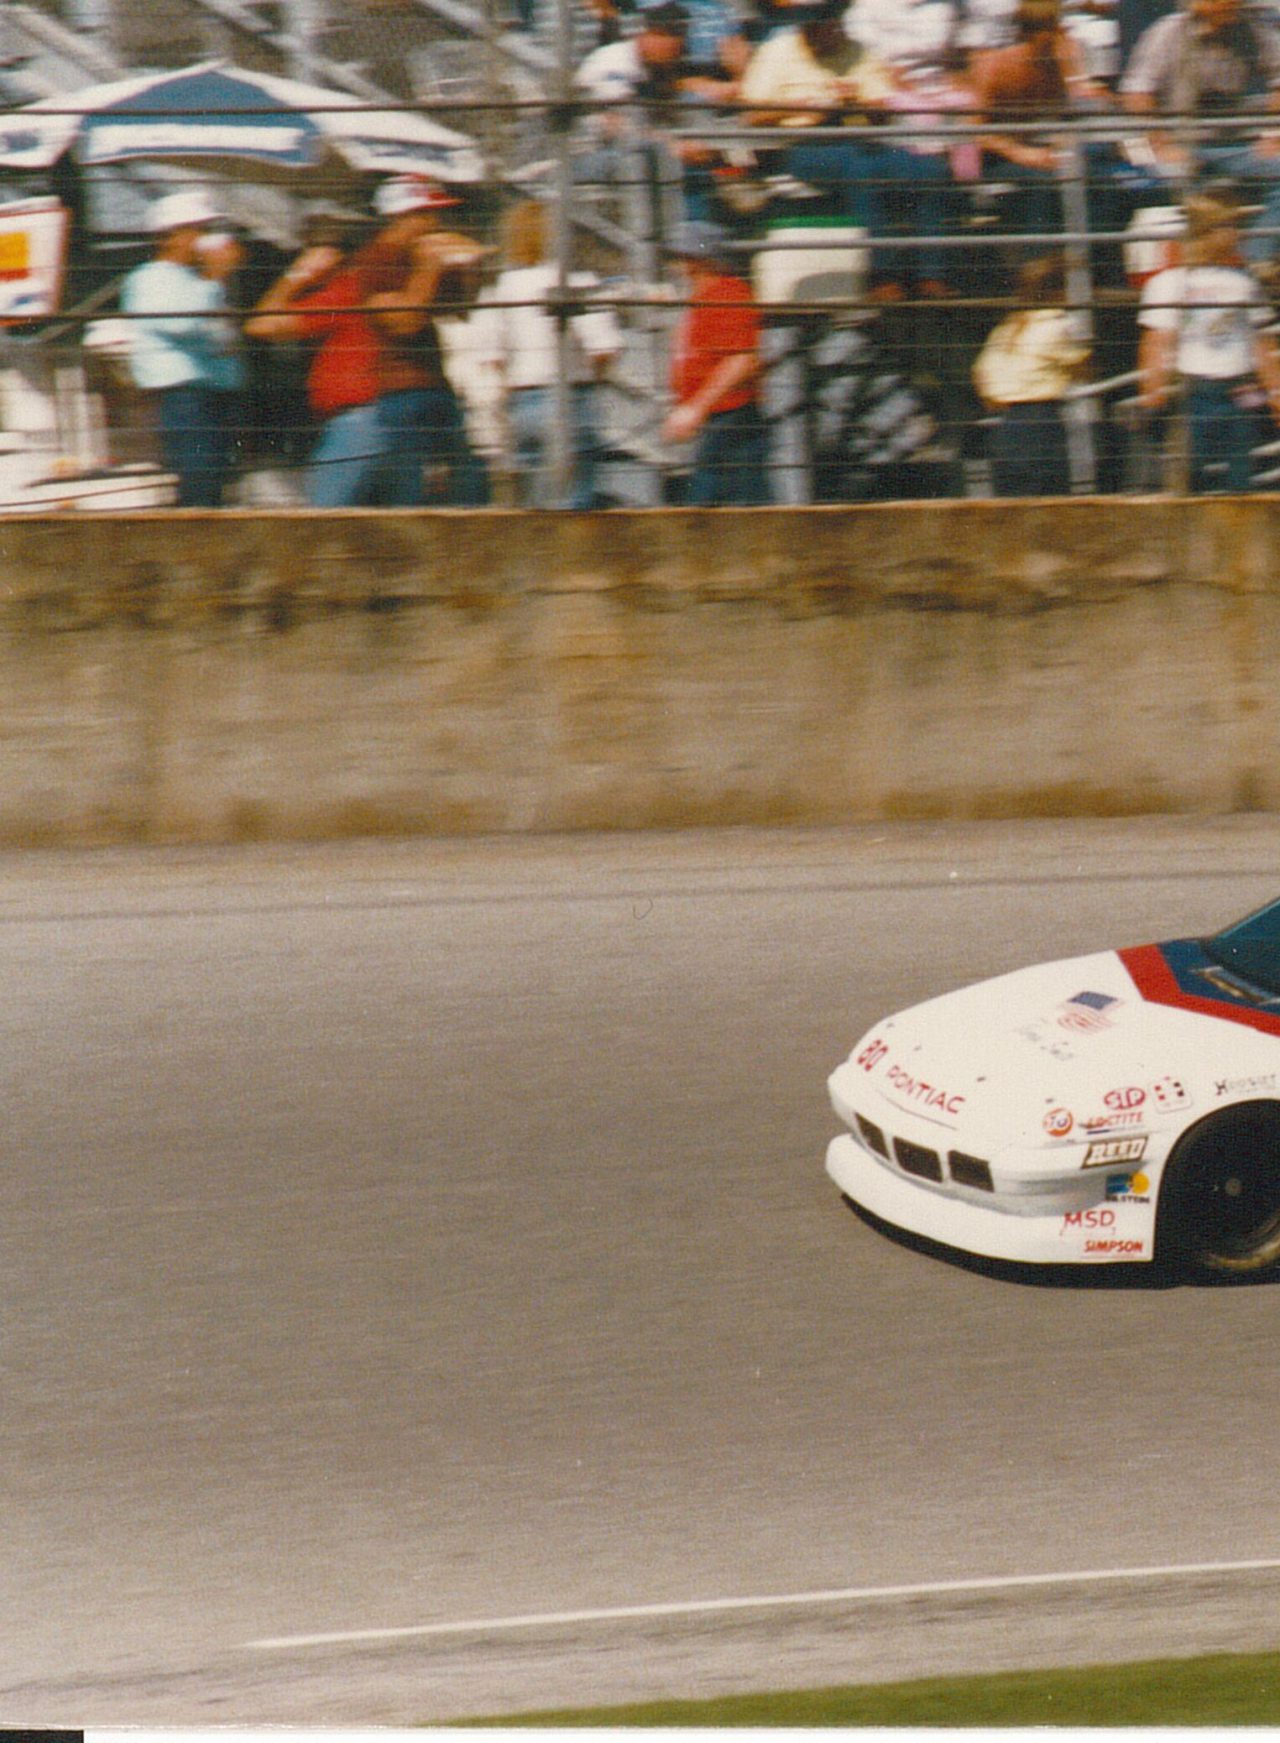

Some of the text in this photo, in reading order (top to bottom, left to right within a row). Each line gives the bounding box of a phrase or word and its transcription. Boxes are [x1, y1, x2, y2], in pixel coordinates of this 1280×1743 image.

[886, 1064, 966, 1114] PONTIAC
[1063, 1209, 1115, 1228] MSD
[1085, 1240, 1143, 1253] SIMPSON
